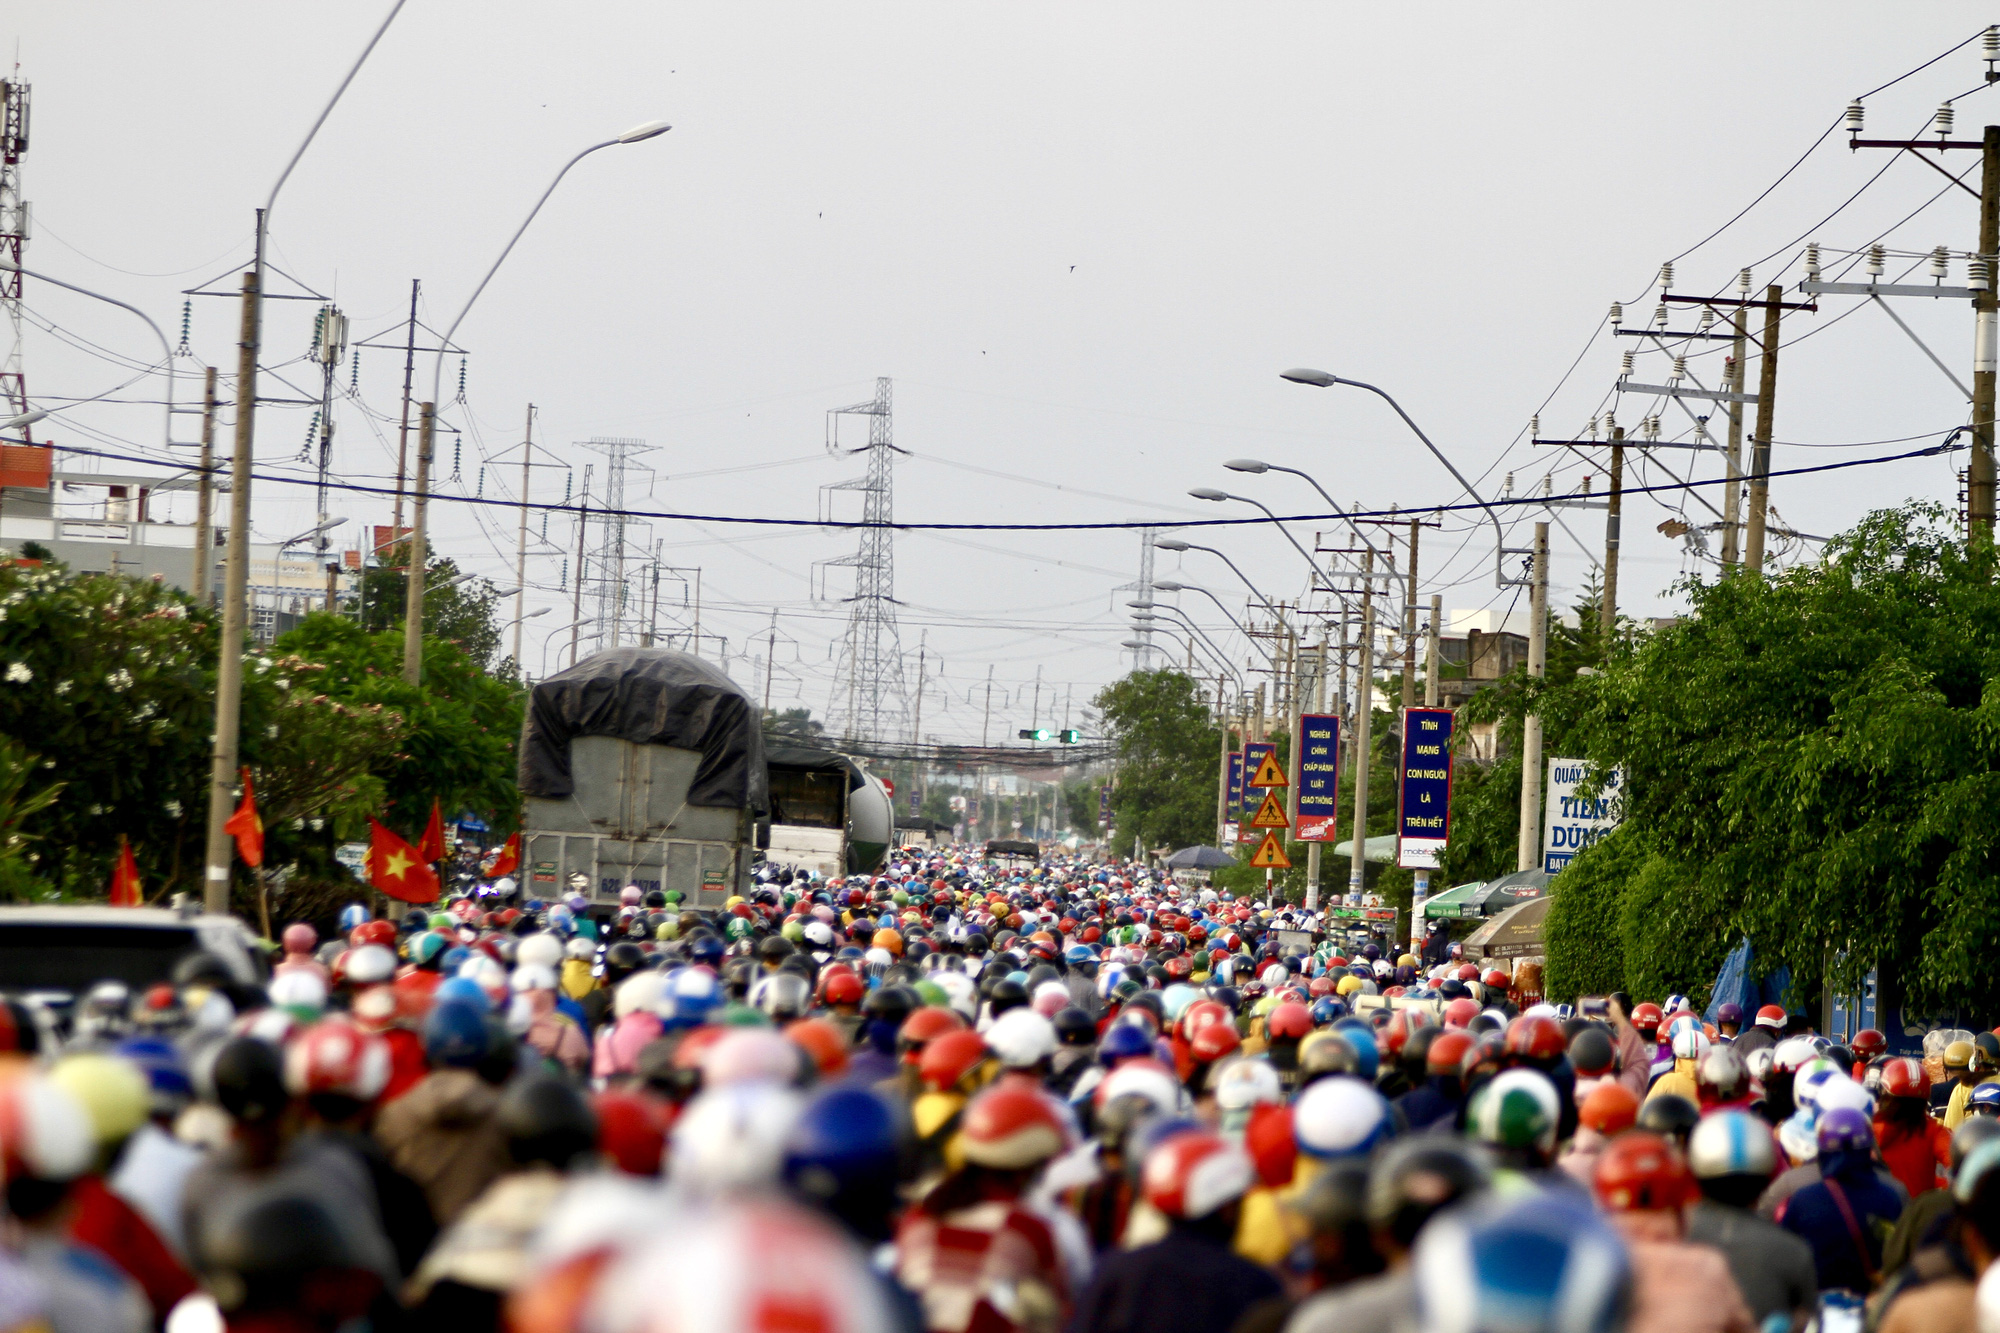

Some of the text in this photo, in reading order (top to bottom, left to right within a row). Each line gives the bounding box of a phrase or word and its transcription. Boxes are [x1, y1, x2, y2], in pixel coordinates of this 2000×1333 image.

[1420, 719, 1438, 730] TÍNH
[1311, 746, 1327, 755] CHÍNH
[1417, 745, 1440, 756] MẠNG
[1407, 769, 1423, 779] CON
[1301, 796, 1333, 805] GIAO THÔNG
[1420, 791, 1431, 803] LÀ
[1406, 816, 1444, 828] TRÊN HẾT
